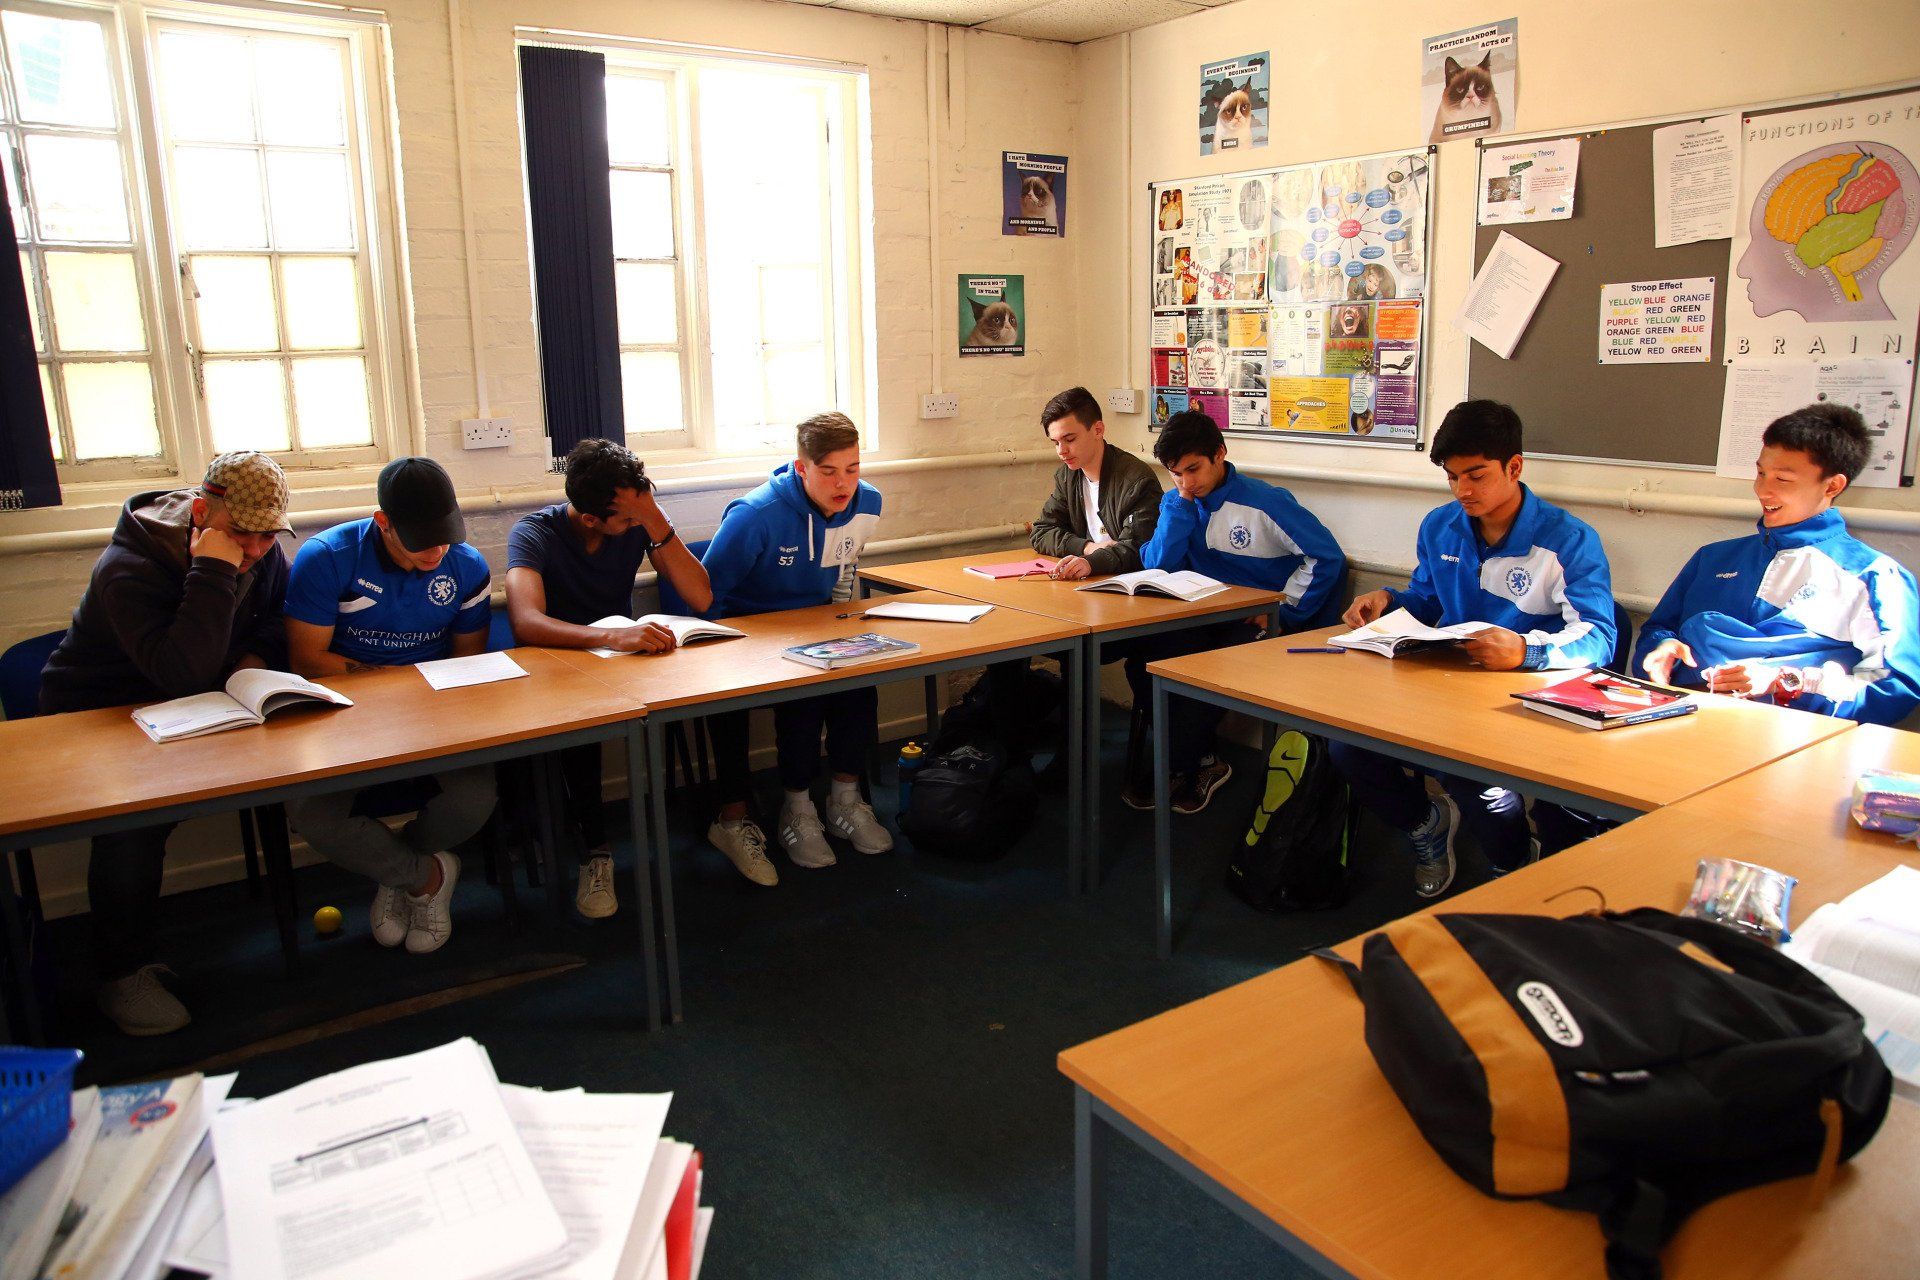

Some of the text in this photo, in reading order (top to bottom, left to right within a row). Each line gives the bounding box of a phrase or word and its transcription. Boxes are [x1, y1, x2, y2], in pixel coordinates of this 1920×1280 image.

[1429, 29, 1497, 52] PRACTICE RANDOM
[1480, 36, 1511, 48] ACTS OF
[1206, 63, 1236, 76] EVERY NEW
[1228, 66, 1258, 77] BEGINNING
[1444, 120, 1489, 133] GRUMPINESS
[1749, 116, 1855, 142] FUNCTIONS
[1867, 110, 1892, 125] OF
[1783, 249, 1808, 278] TEMPORAL
[1856, 240, 1894, 281] CEREBELLUM
[1818, 266, 1833, 287] BRAIN
[1631, 282, 1683, 292] Stroop Effect
[1609, 294, 1711, 306] YELLOW BLUE ORANGE
[1670, 305, 1701, 313] GREEN
[1606, 318, 1639, 326] PURPLE
[1645, 316, 1681, 324] YELLOW
[1606, 328, 1641, 336] ORANGE
[1681, 325, 1705, 333] BLUE
[1612, 338, 1634, 346] BLUE
[1737, 334, 1902, 354] BRAIN
[1608, 348, 1642, 356] YELLOW
[1671, 346, 1702, 354] GREEN
[778, 556, 794, 566] 53
[365, 581, 384, 594] errea
[347, 626, 444, 641] NOTTINGHAM
